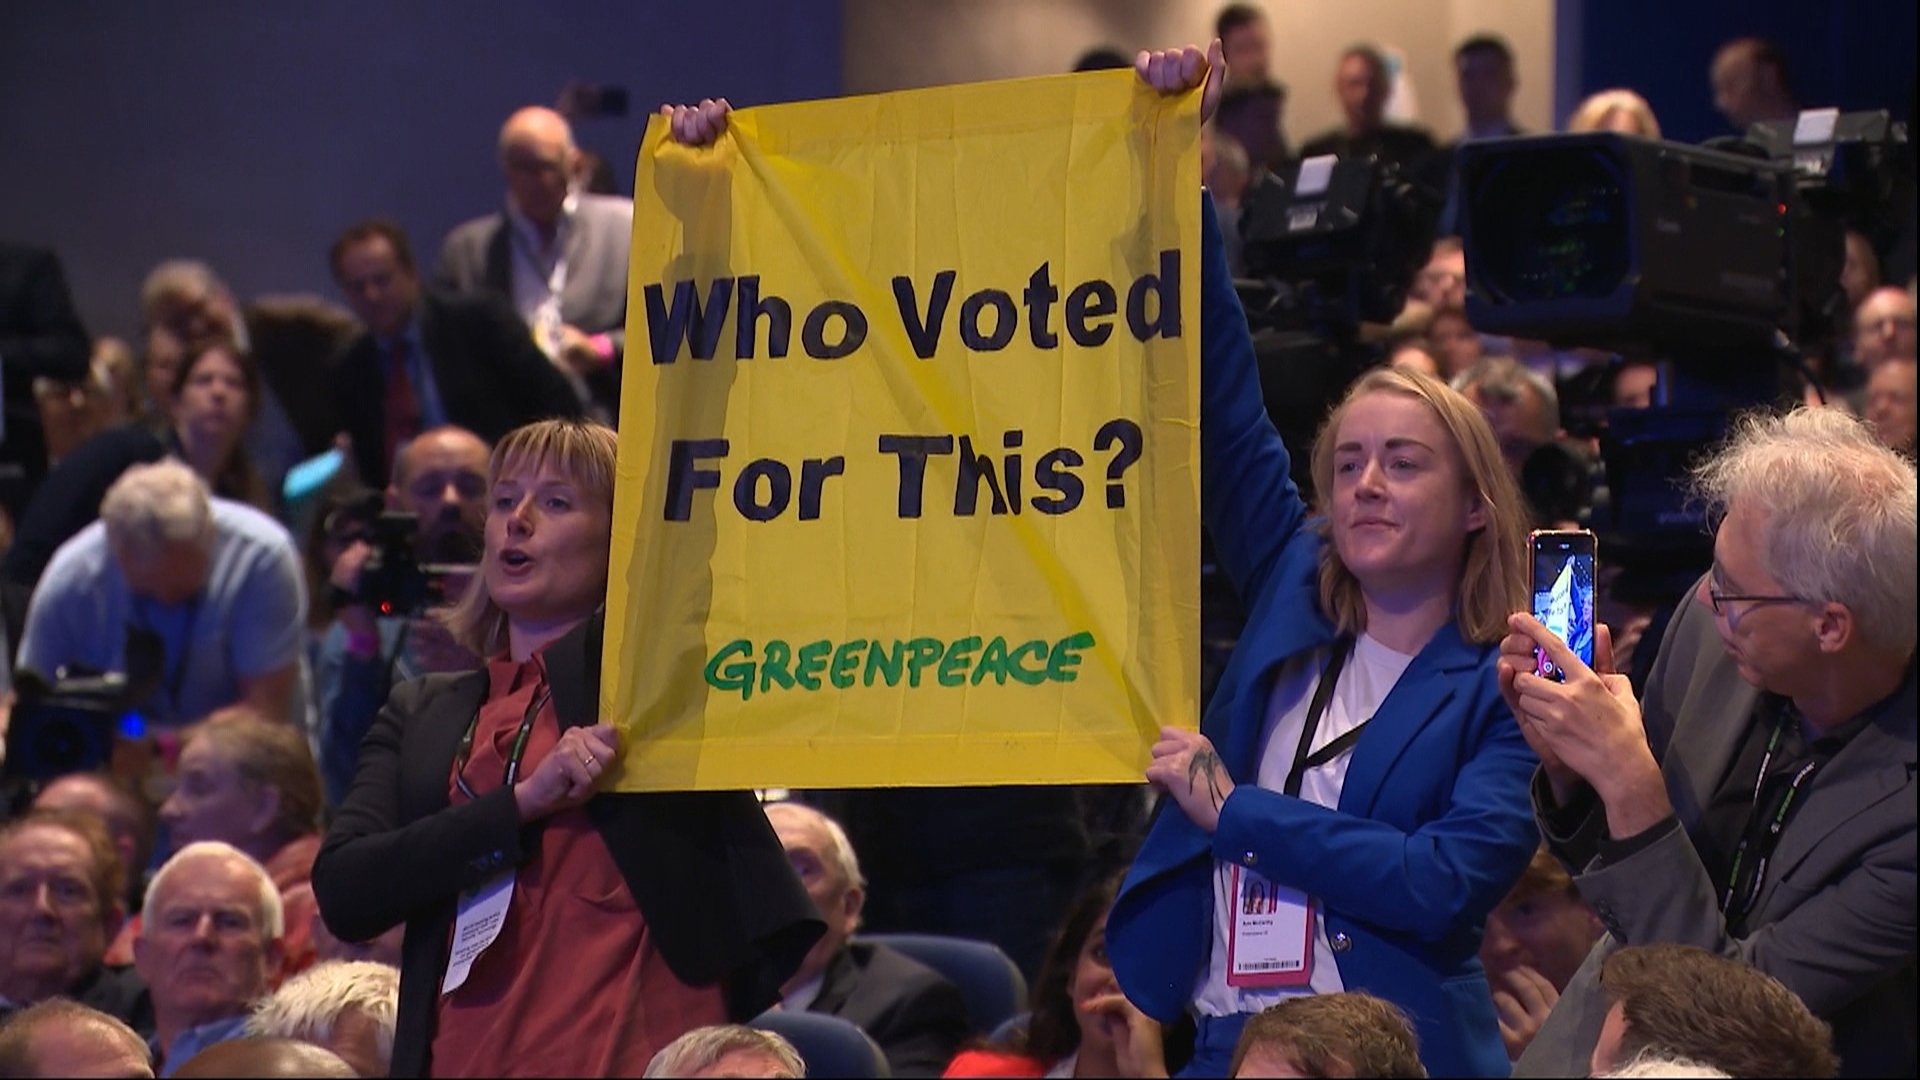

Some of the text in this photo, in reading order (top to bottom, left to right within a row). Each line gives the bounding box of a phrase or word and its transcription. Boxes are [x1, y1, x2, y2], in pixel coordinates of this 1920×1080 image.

[644, 249, 1181, 365] Who Voted
[664, 419, 1144, 522] For This?
[703, 631, 1095, 700] GREENPEACE
